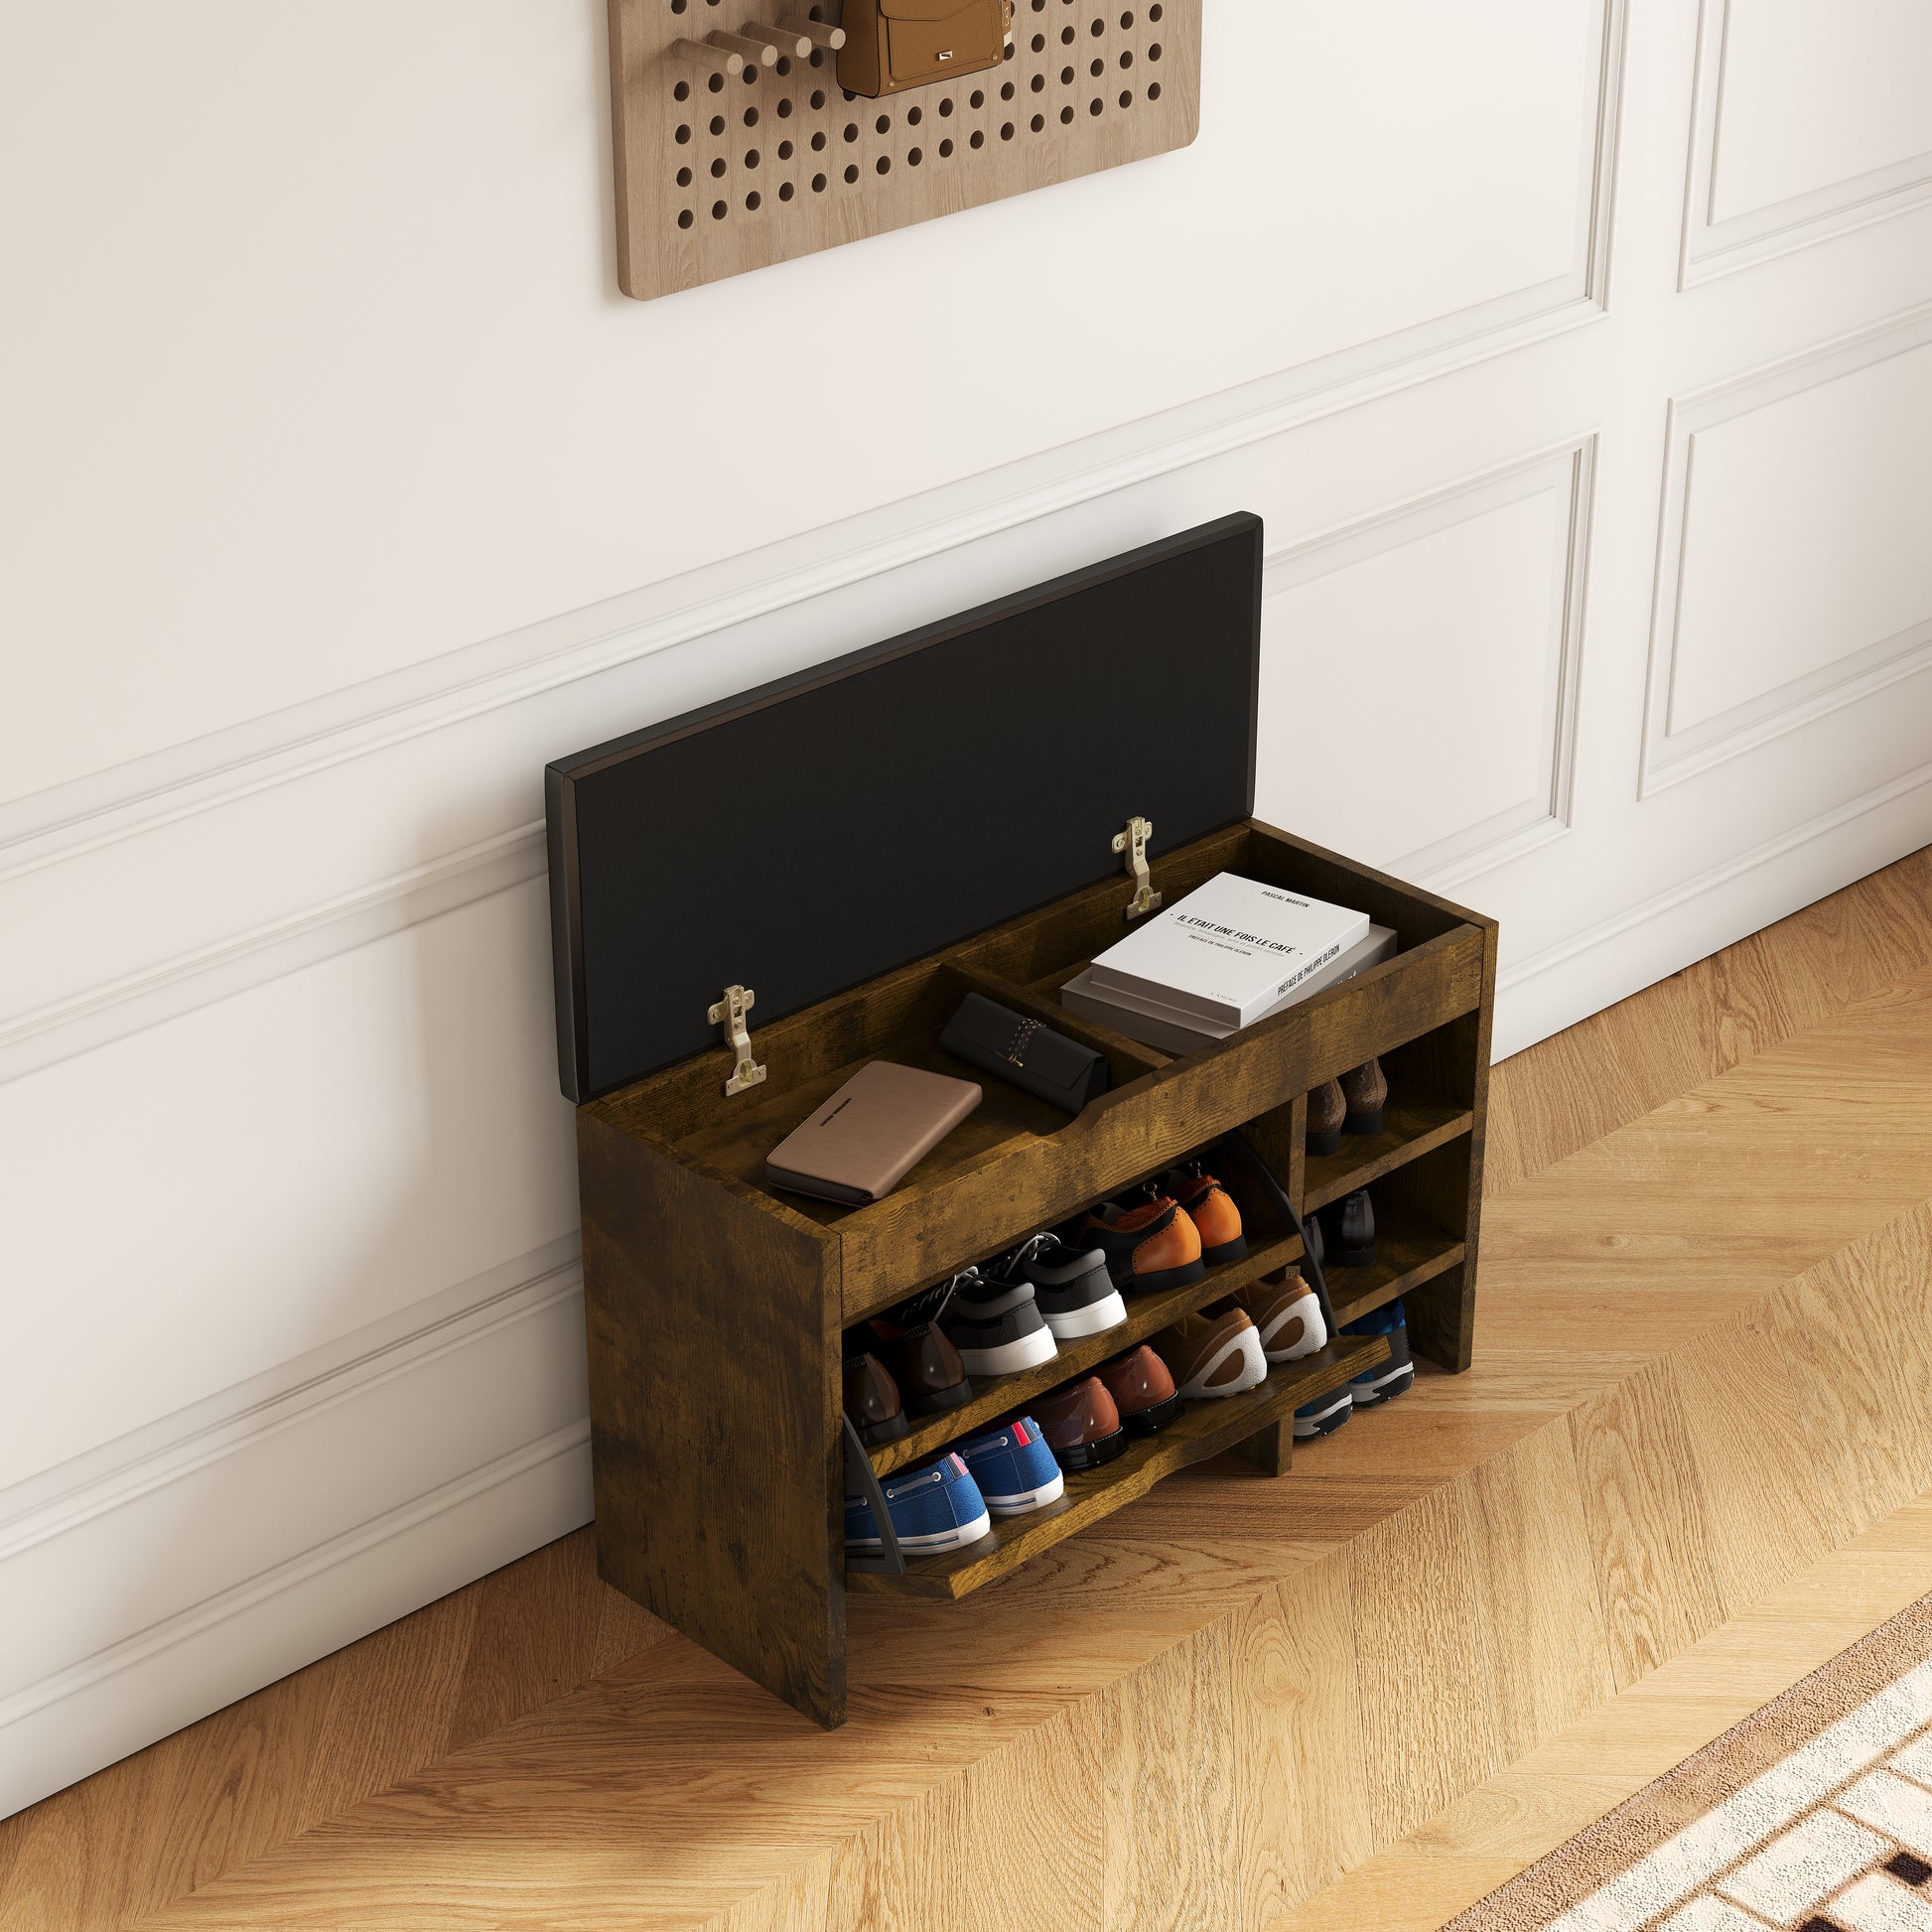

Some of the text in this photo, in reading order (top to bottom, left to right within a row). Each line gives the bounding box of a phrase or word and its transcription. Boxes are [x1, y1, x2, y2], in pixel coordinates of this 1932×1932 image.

[1261, 890, 1311, 908] PASCAL MARTIN
[1187, 915, 1216, 929] ÉTAIT
[1214, 927, 1236, 936] UNE
[1233, 931, 1258, 942] FOIS
[1256, 938, 1271, 947] LE
[1268, 942, 1297, 954] CAFÉ
[1277, 974, 1297, 996] PRÉFACE
[1297, 970, 1304, 982] DE
[1304, 955, 1322, 977] PHILIPPE
